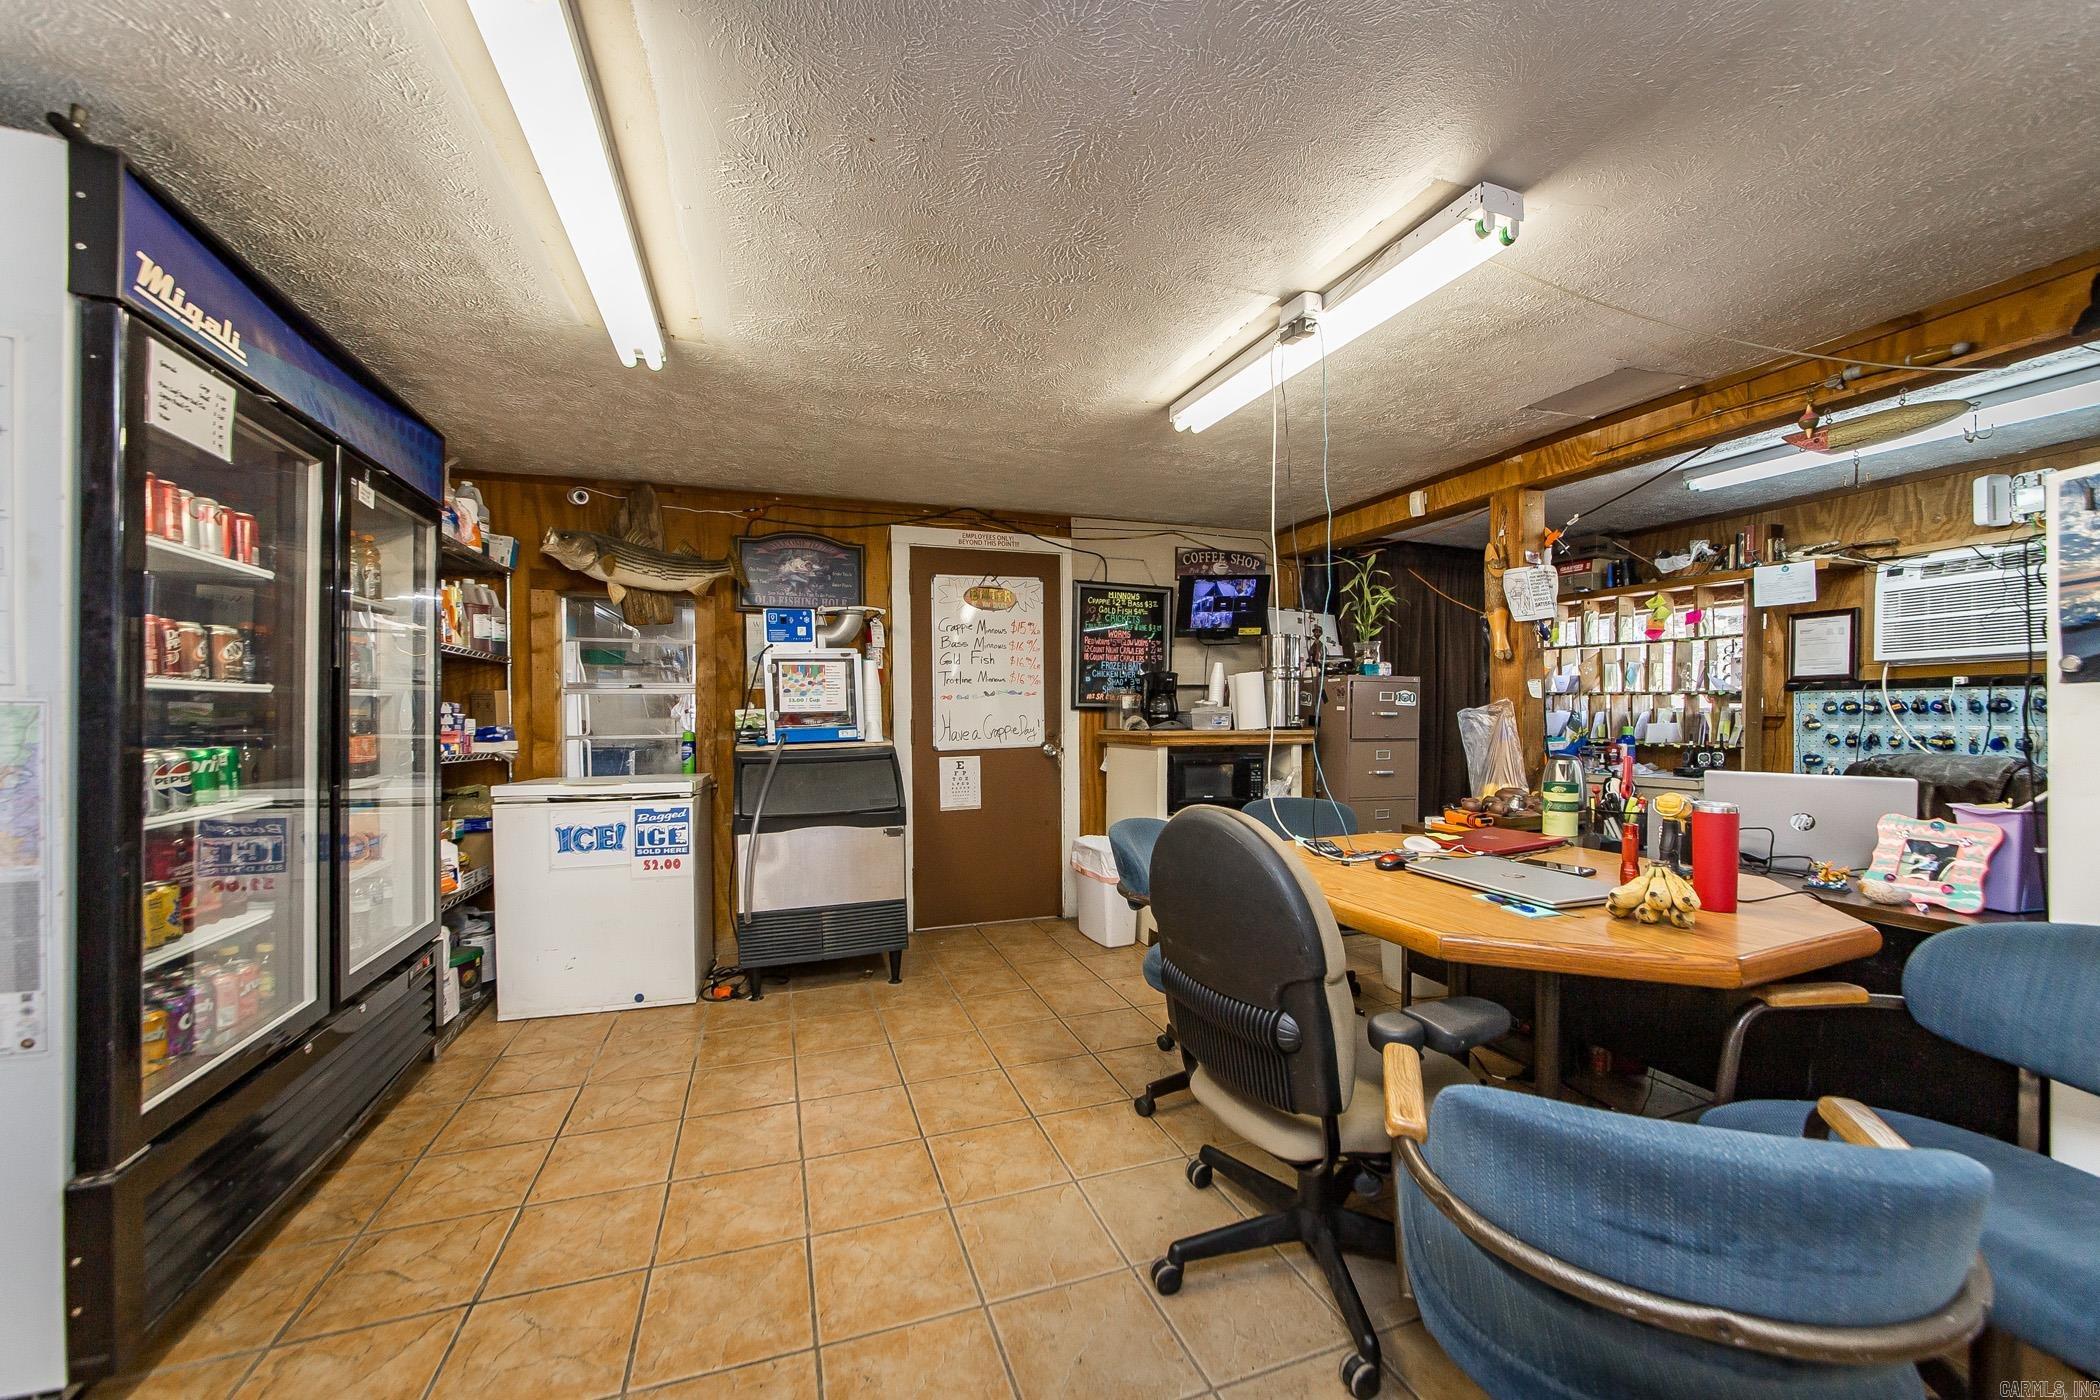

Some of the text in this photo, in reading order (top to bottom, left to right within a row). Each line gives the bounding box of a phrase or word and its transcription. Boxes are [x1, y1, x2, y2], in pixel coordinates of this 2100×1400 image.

[135, 251, 247, 360] Migali
[962, 532, 996, 541] EMPLOYEES
[1182, 551, 1260, 570] COFFEE SHOP
[755, 594, 776, 605] OLD
[779, 595, 818, 606] FISHING
[820, 598, 848, 607] HOLE
[1108, 591, 1140, 600] MINNOWS
[1098, 605, 1116, 614] GOLD
[1117, 605, 1133, 615] FISH
[1104, 614, 1140, 624] CRICKETS
[938, 617, 973, 635] Crappie
[1107, 629, 1132, 639] WORMS
[940, 635, 969, 650] Bass
[939, 651, 961, 665] Gold
[970, 650, 995, 665] Fish
[1100, 661, 1126, 670] FROZEN
[937, 670, 973, 686] Trotline
[1091, 669, 1118, 678] CHICKEN
[1107, 677, 1123, 686] SHAD
[937, 709, 969, 742] Have
[972, 730, 981, 740] a
[1018, 714, 1040, 743] Day!
[956, 760, 965, 770] E
[637, 808, 687, 823] Bagged
[555, 821, 627, 853] ICE!
[637, 825, 688, 847] ICE
[643, 858, 681, 871] $2.00
